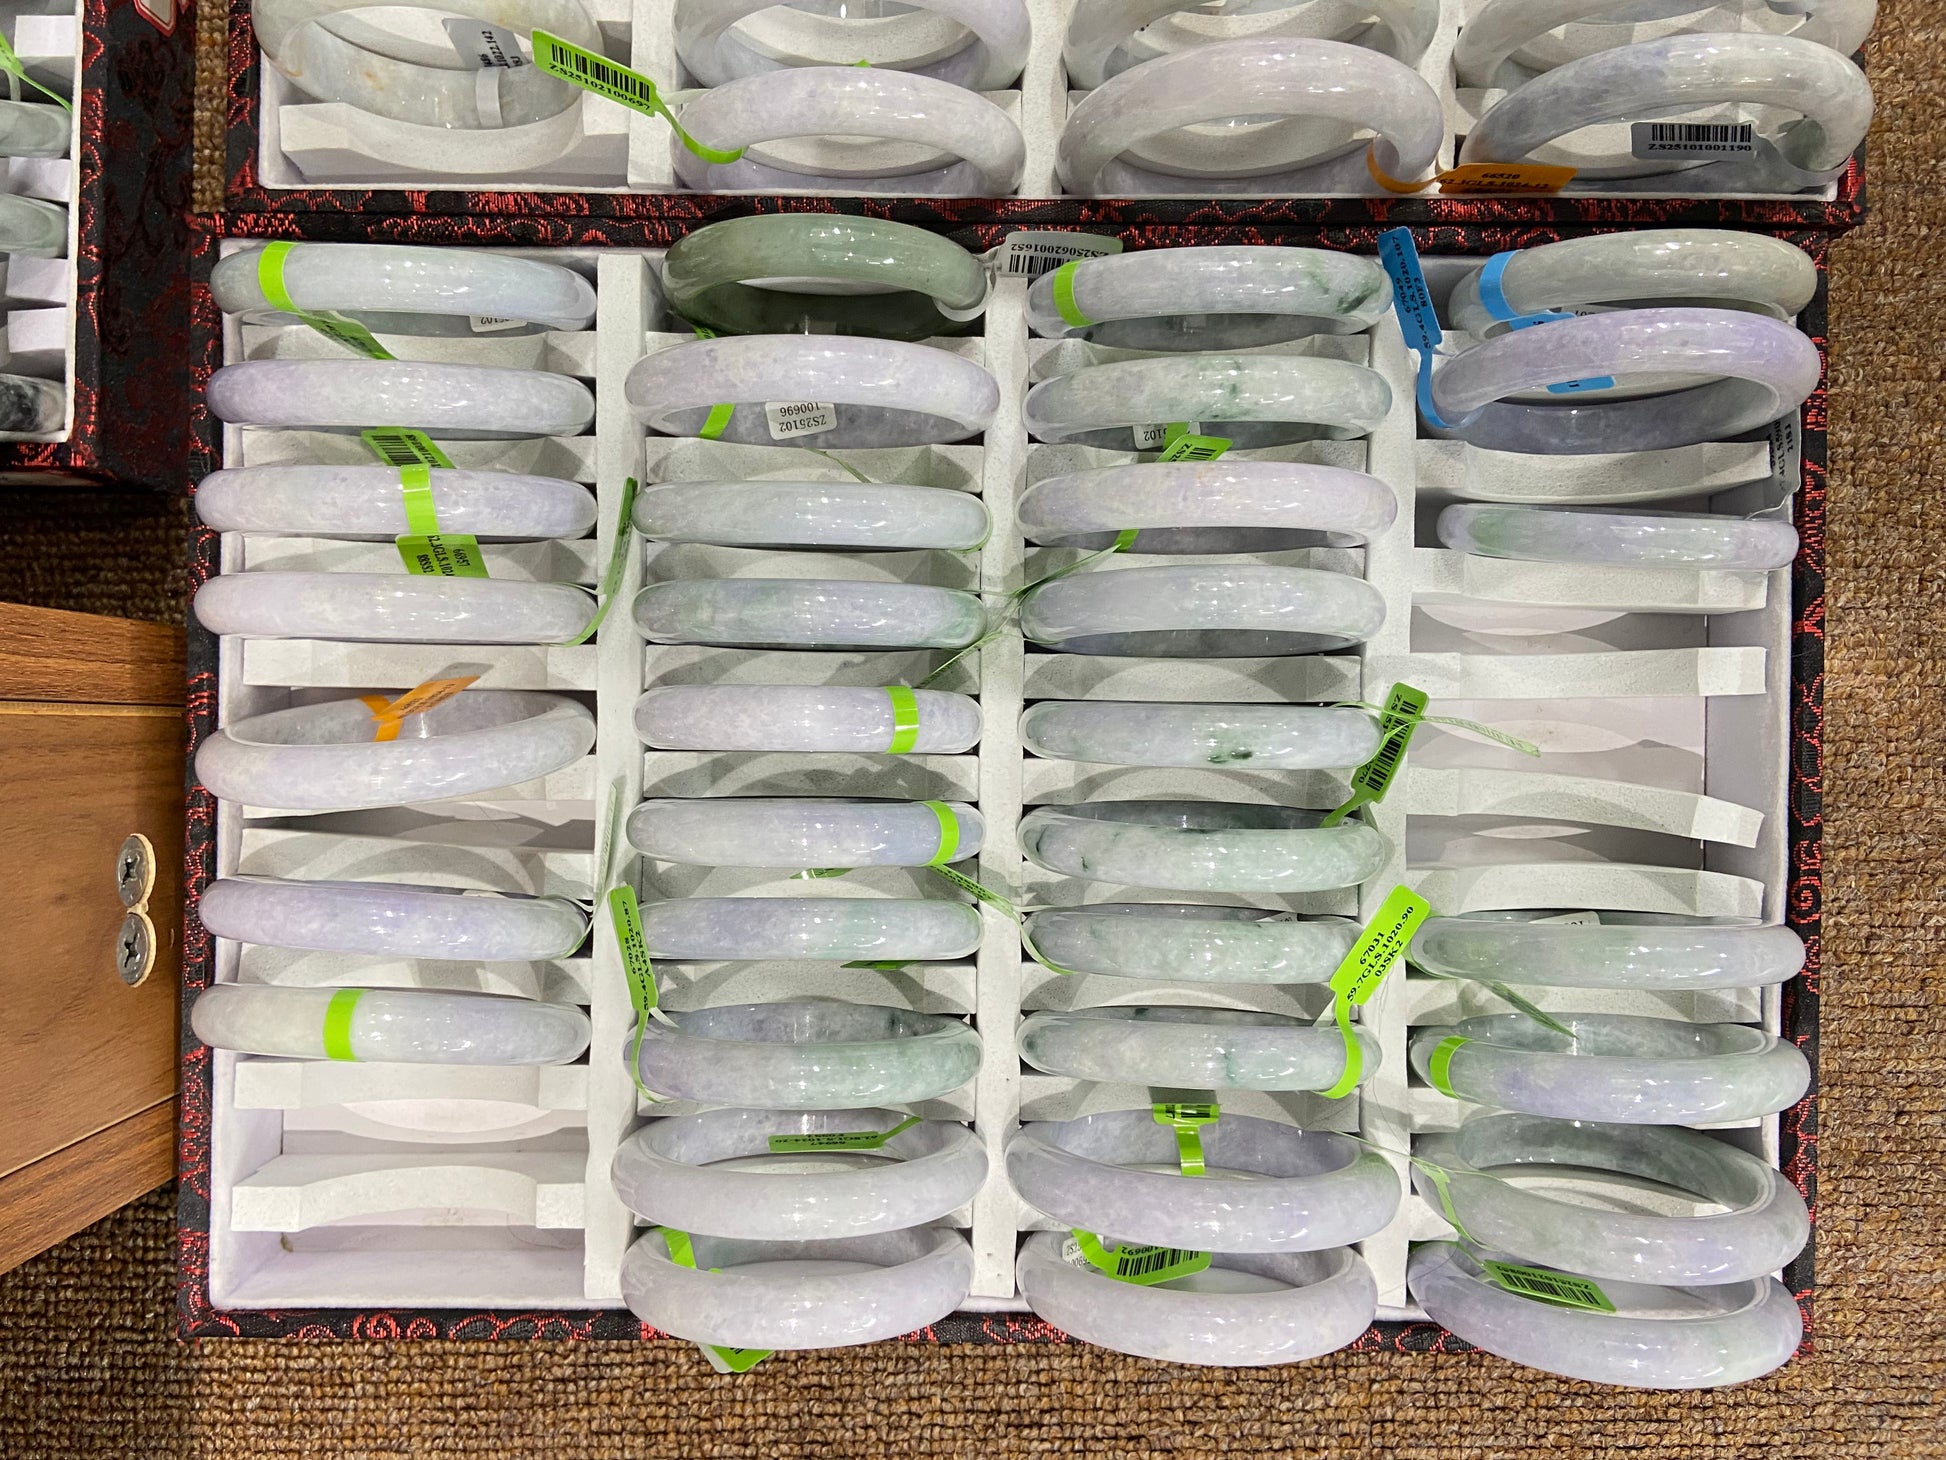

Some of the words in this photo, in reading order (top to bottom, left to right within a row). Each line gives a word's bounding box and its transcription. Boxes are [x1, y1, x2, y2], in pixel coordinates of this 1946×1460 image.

[549, 62, 651, 111] ZS25102100697
[1648, 142, 1752, 152] ZS25101001190
[1395, 276, 1411, 314] 67049
[778, 413, 827, 433] ZS25102
[779, 402, 821, 417] 100696
[624, 936, 637, 975] 67028
[1346, 906, 1414, 1002] 59.7GLS.1020.90
[1359, 932, 1385, 965] 67031
[1374, 939, 1404, 978] 03SK2
